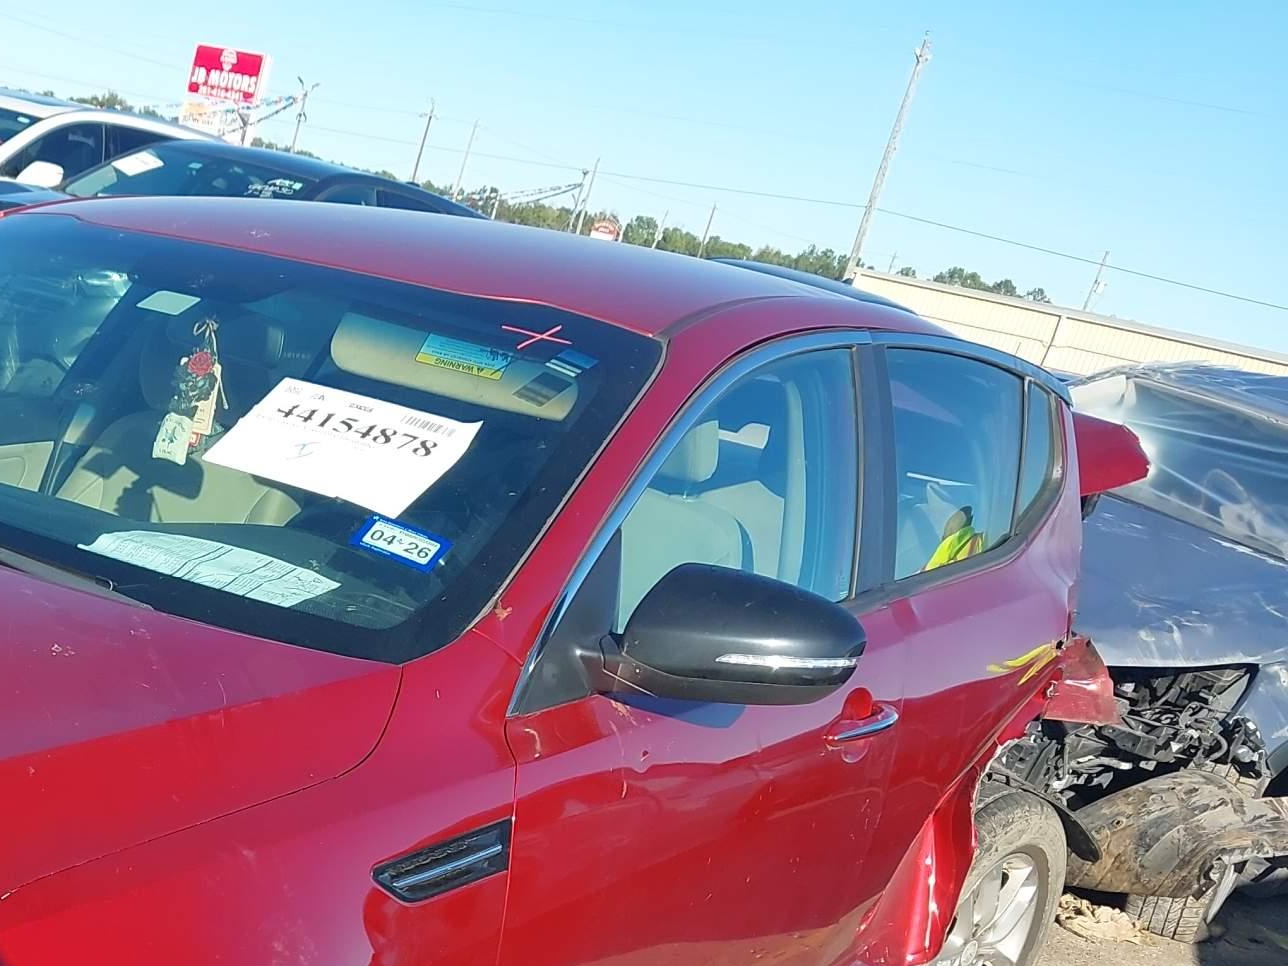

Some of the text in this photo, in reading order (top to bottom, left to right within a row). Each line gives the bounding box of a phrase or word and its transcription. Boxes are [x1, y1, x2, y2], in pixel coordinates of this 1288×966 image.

[208, 68, 258, 94] MOTORS
[434, 357, 474, 374] WARNING
[277, 404, 438, 457] 44154878
[370, 529, 397, 546] 04
[403, 541, 432, 559] 26
